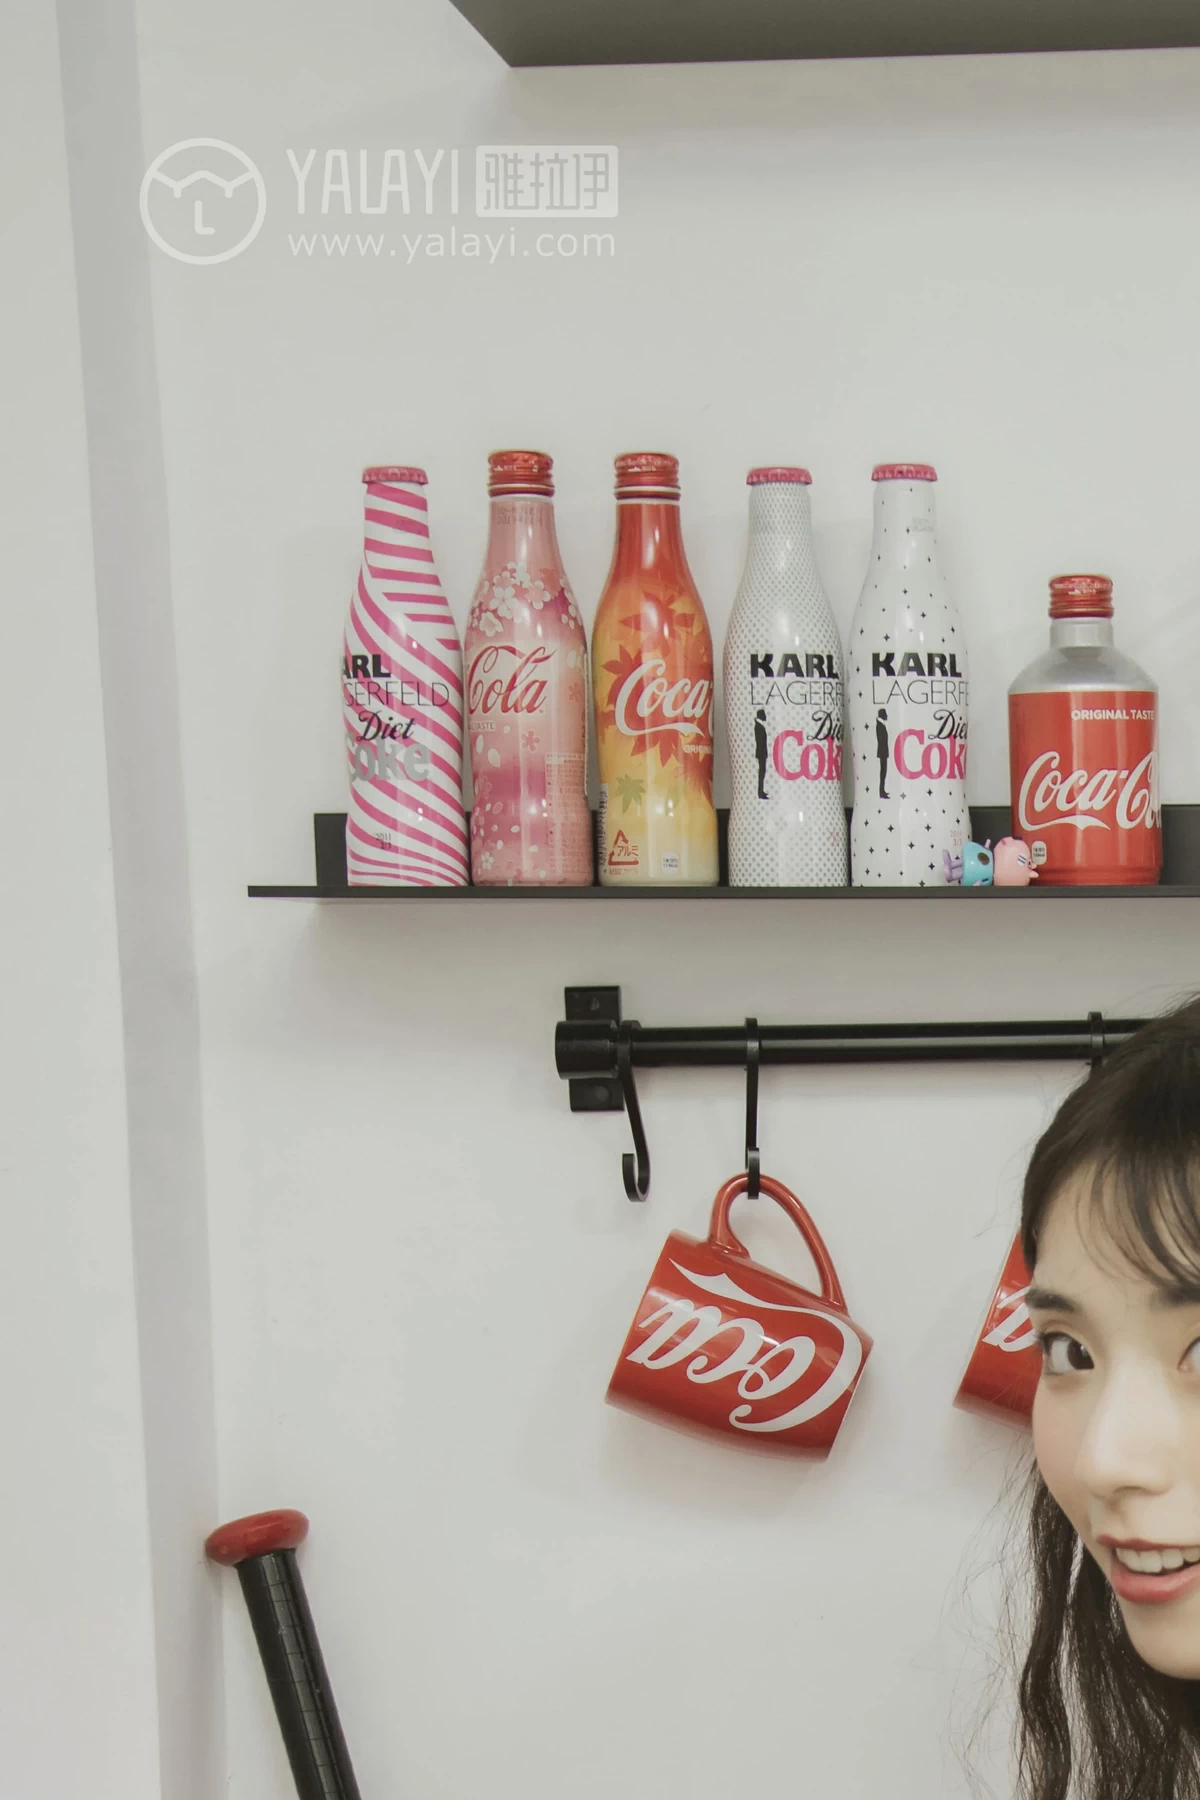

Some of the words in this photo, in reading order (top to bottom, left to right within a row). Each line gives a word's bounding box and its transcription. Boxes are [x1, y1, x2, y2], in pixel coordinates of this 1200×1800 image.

[750, 653, 839, 679] KARL
[872, 652, 962, 678] KARL
[355, 710, 416, 742] Diet
[1071, 709, 1129, 720] ORIGINAL
[1131, 709, 1155, 720] TASTE
[772, 729, 843, 781] Cok
[617, 845, 639, 857] アルミ
[627, 1258, 863, 1433] Coca
